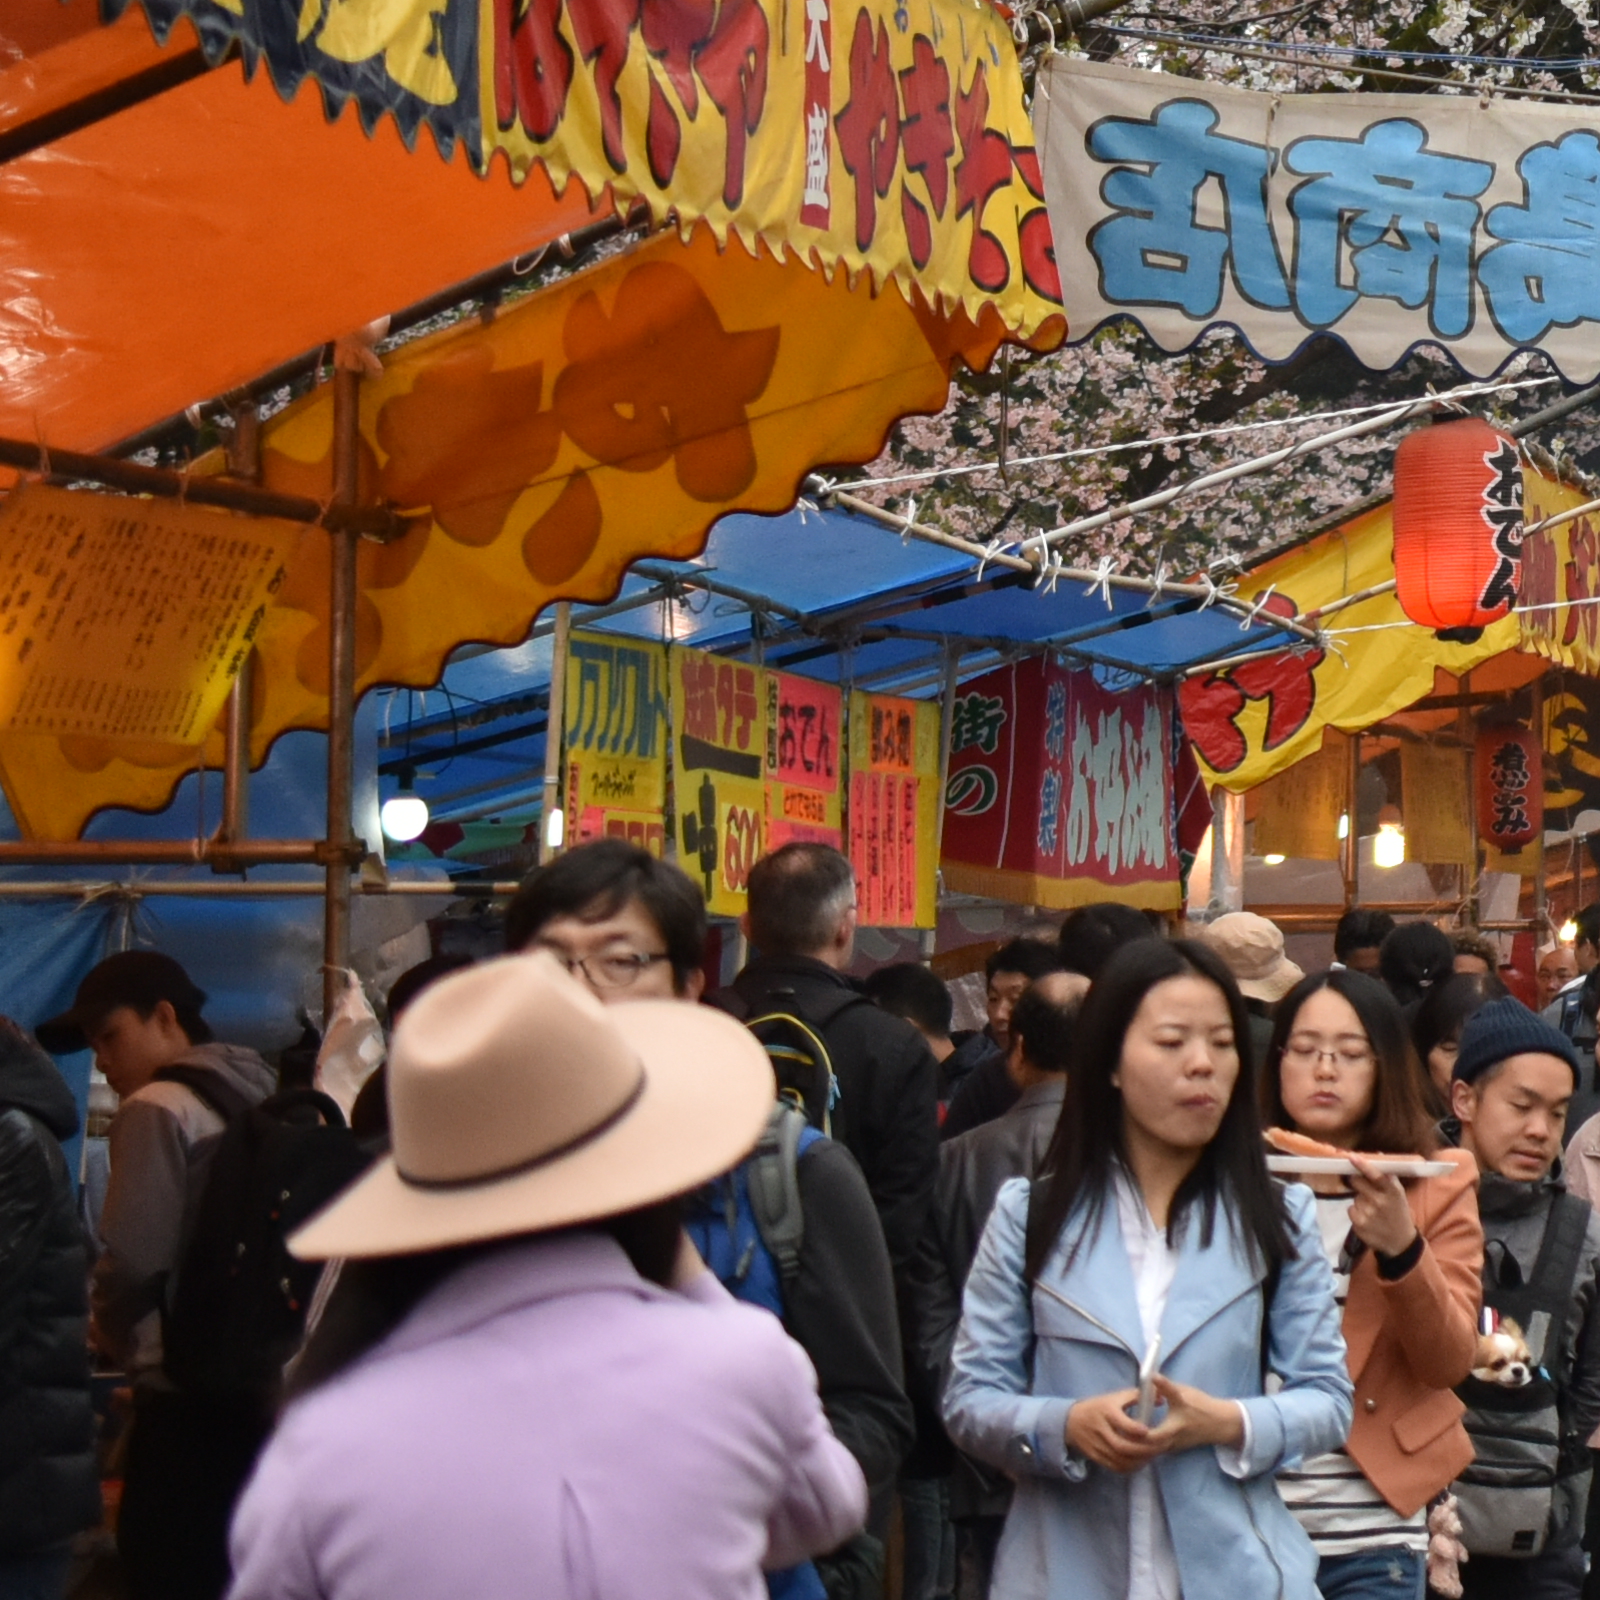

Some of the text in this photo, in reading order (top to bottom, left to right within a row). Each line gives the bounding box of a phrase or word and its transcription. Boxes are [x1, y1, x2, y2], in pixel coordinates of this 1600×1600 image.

[1475, 434, 1523, 611] おでん
[779, 697, 833, 777] おでん
[1490, 741, 1532, 836] 煮こみ
